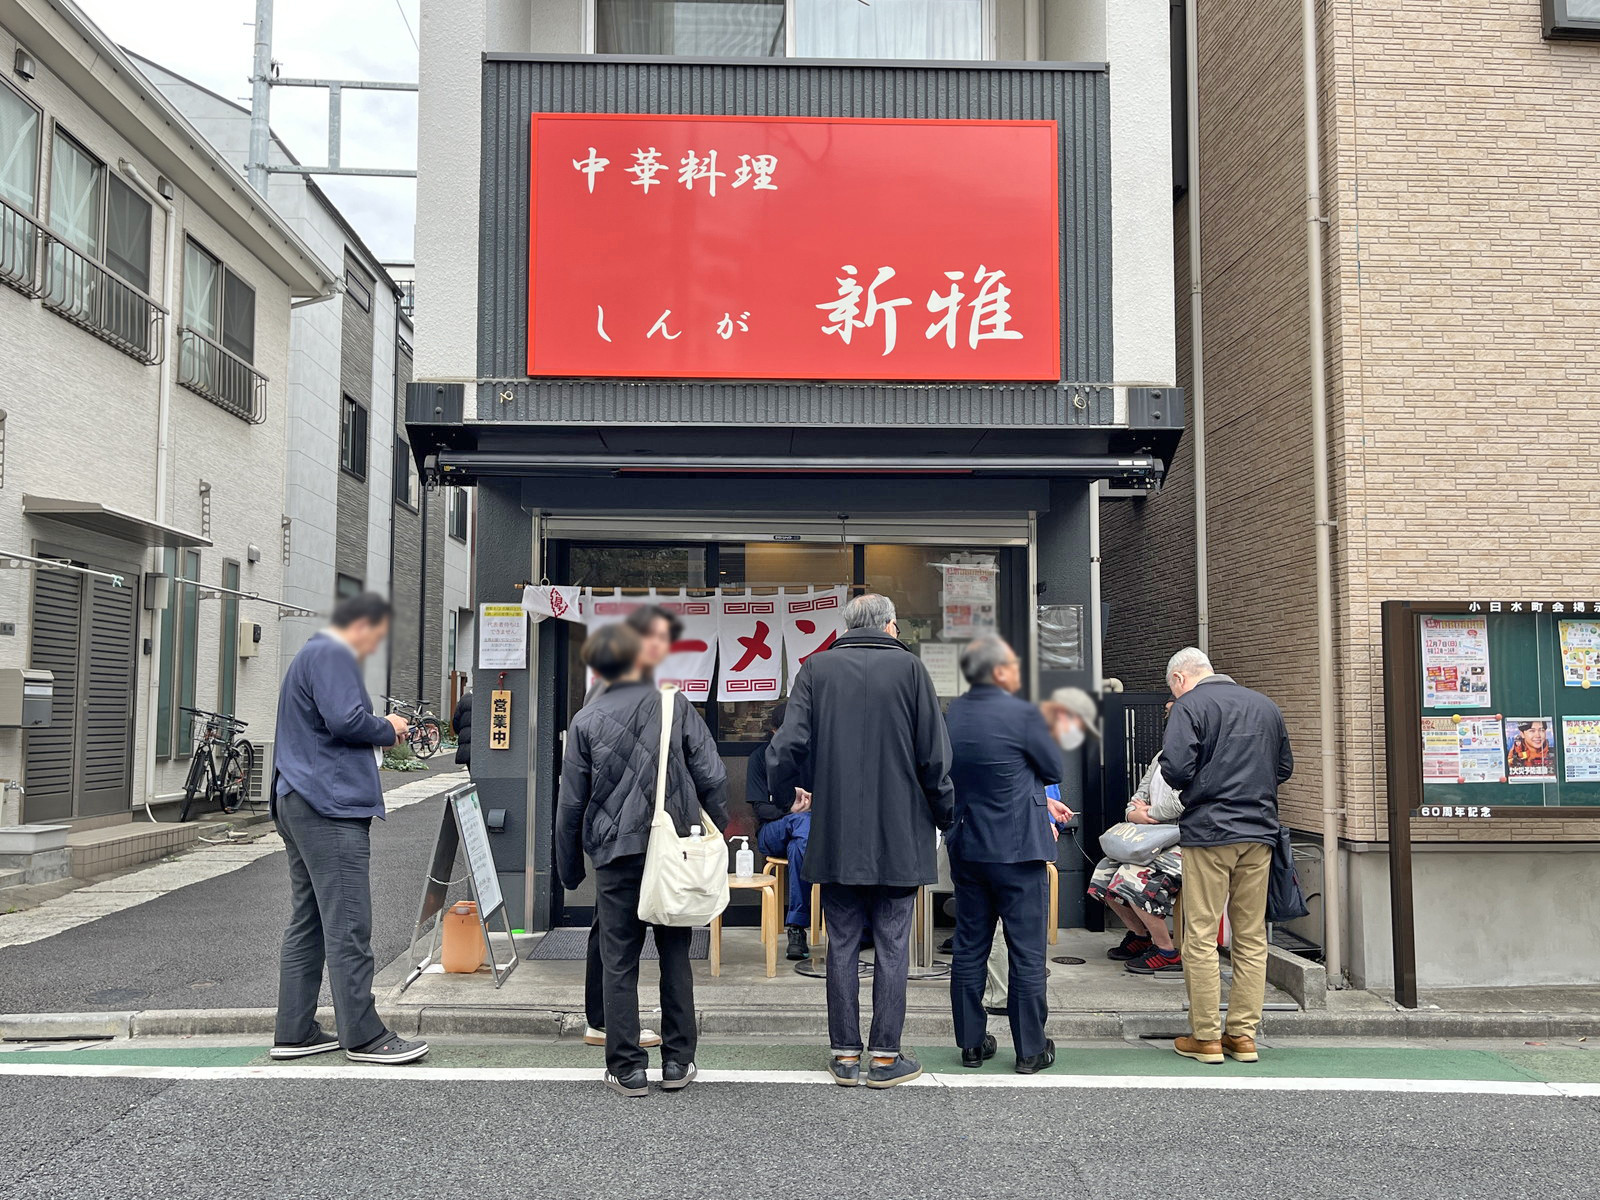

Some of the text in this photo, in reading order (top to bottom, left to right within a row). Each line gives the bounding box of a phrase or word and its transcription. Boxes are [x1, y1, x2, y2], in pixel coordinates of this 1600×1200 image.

[572, 147, 779, 198] 中華料理
[597, 306, 751, 343] しんが
[815, 265, 1024, 356] 新雅
[493, 698, 507, 745] 営業中
[1421, 806, 1492, 818] 60周年記念
